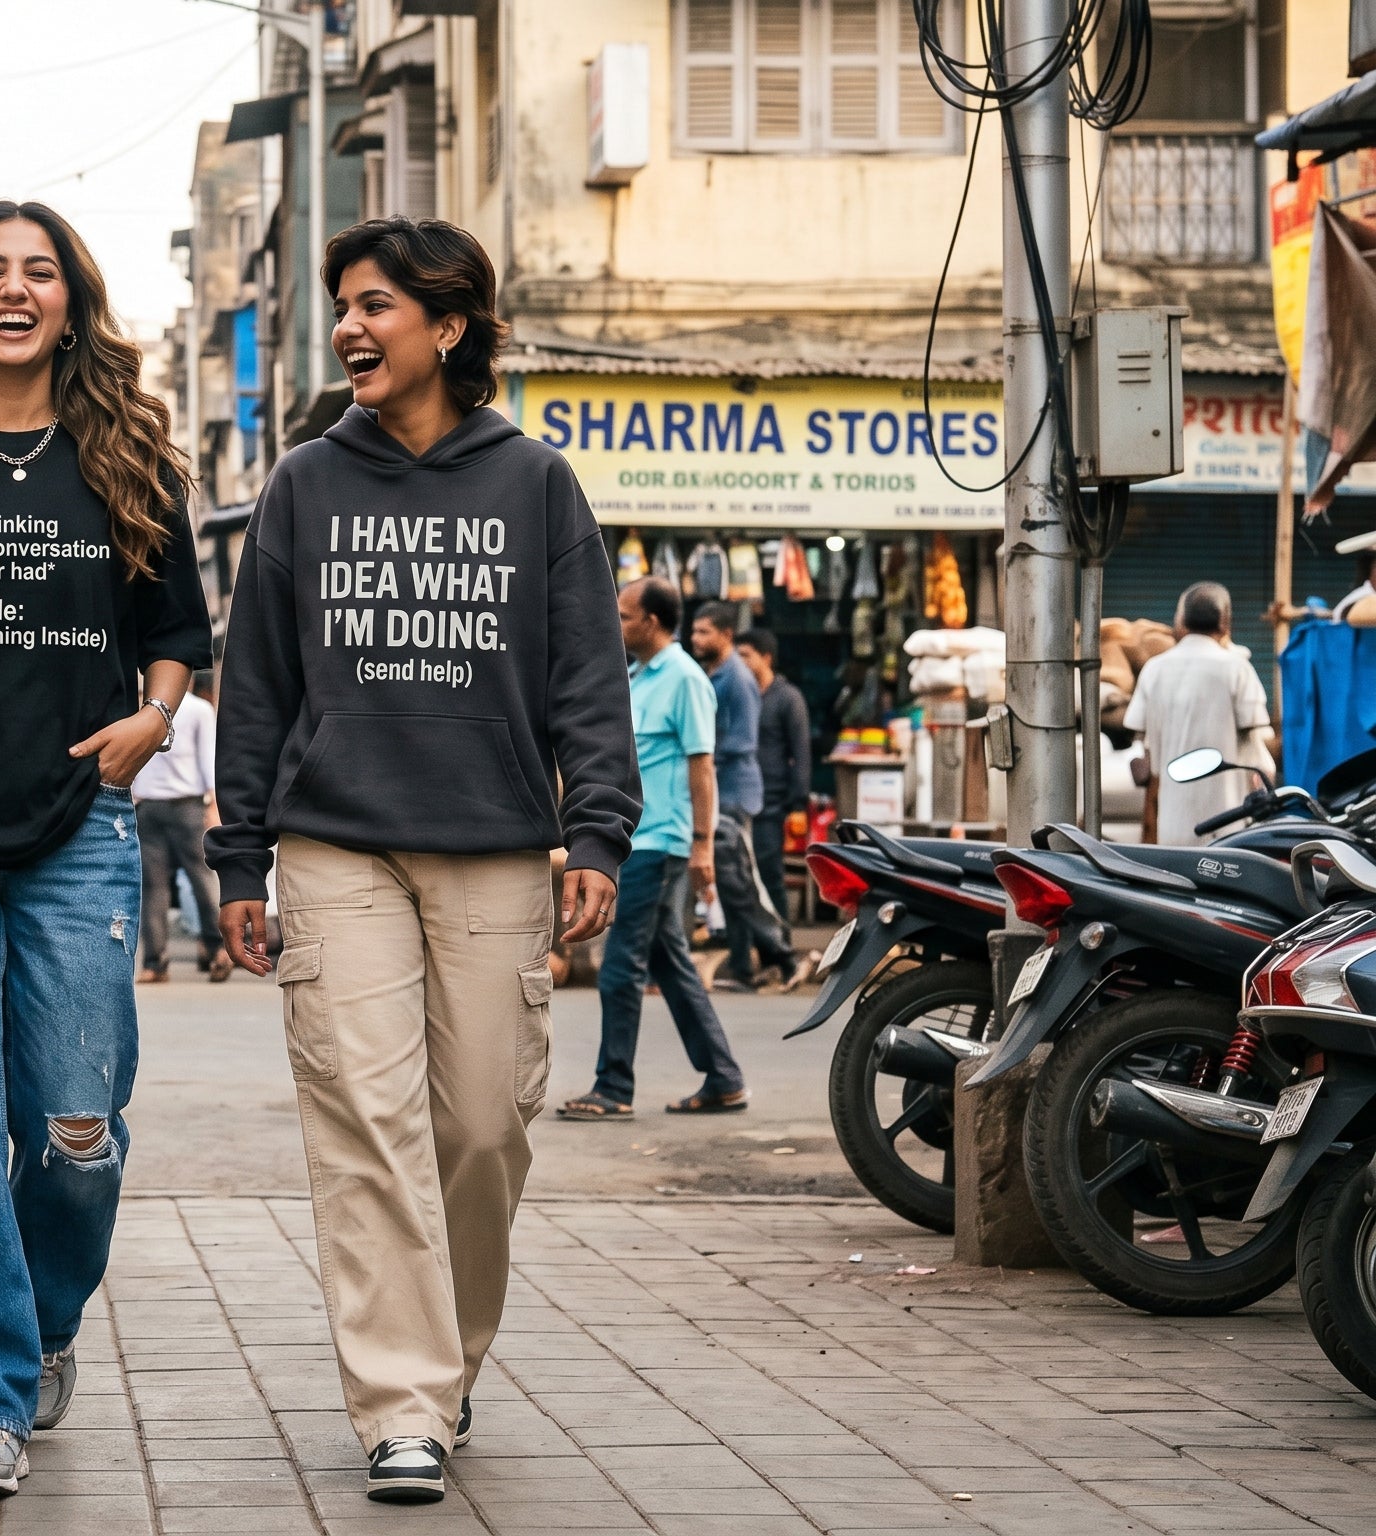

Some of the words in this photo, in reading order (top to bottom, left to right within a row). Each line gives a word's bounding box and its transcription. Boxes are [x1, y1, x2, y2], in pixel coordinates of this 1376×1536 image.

[542, 400, 785, 454] SHARMA
[806, 409, 999, 457] STORES
[330, 515, 340, 553] I
[351, 515, 446, 554] HAVE
[455, 517, 506, 556] NO
[320, 560, 400, 600] IDEA
[410, 561, 516, 603] WHAT
[41, 626, 108, 653] Inside)
[386, 609, 507, 652] DOING.
[356, 656, 415, 685] (send
[420, 658, 473, 689] help)
